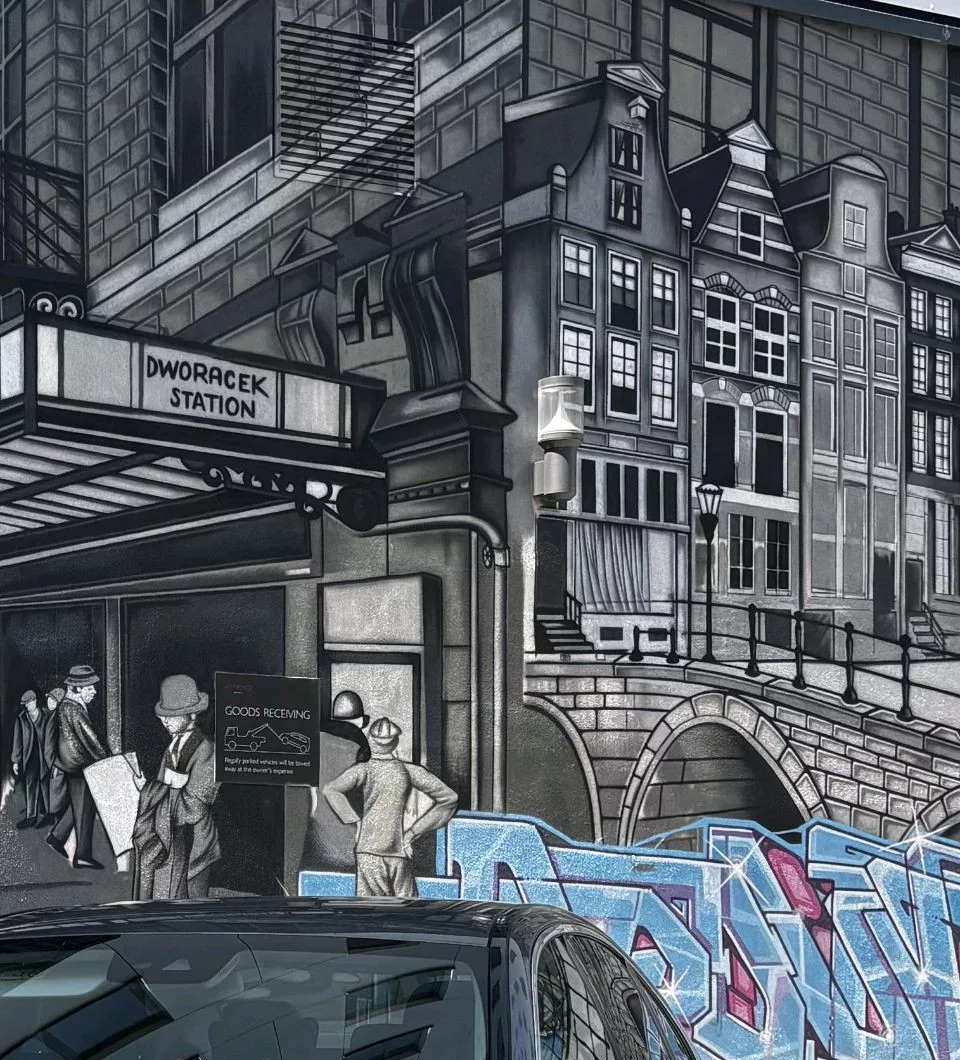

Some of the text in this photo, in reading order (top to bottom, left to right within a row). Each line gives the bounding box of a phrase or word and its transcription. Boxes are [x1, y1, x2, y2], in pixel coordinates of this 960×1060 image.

[146, 354, 270, 399] DWORACEK
[170, 387, 256, 419] STATION
[224, 705, 311, 720] GOODS RECEIVING
